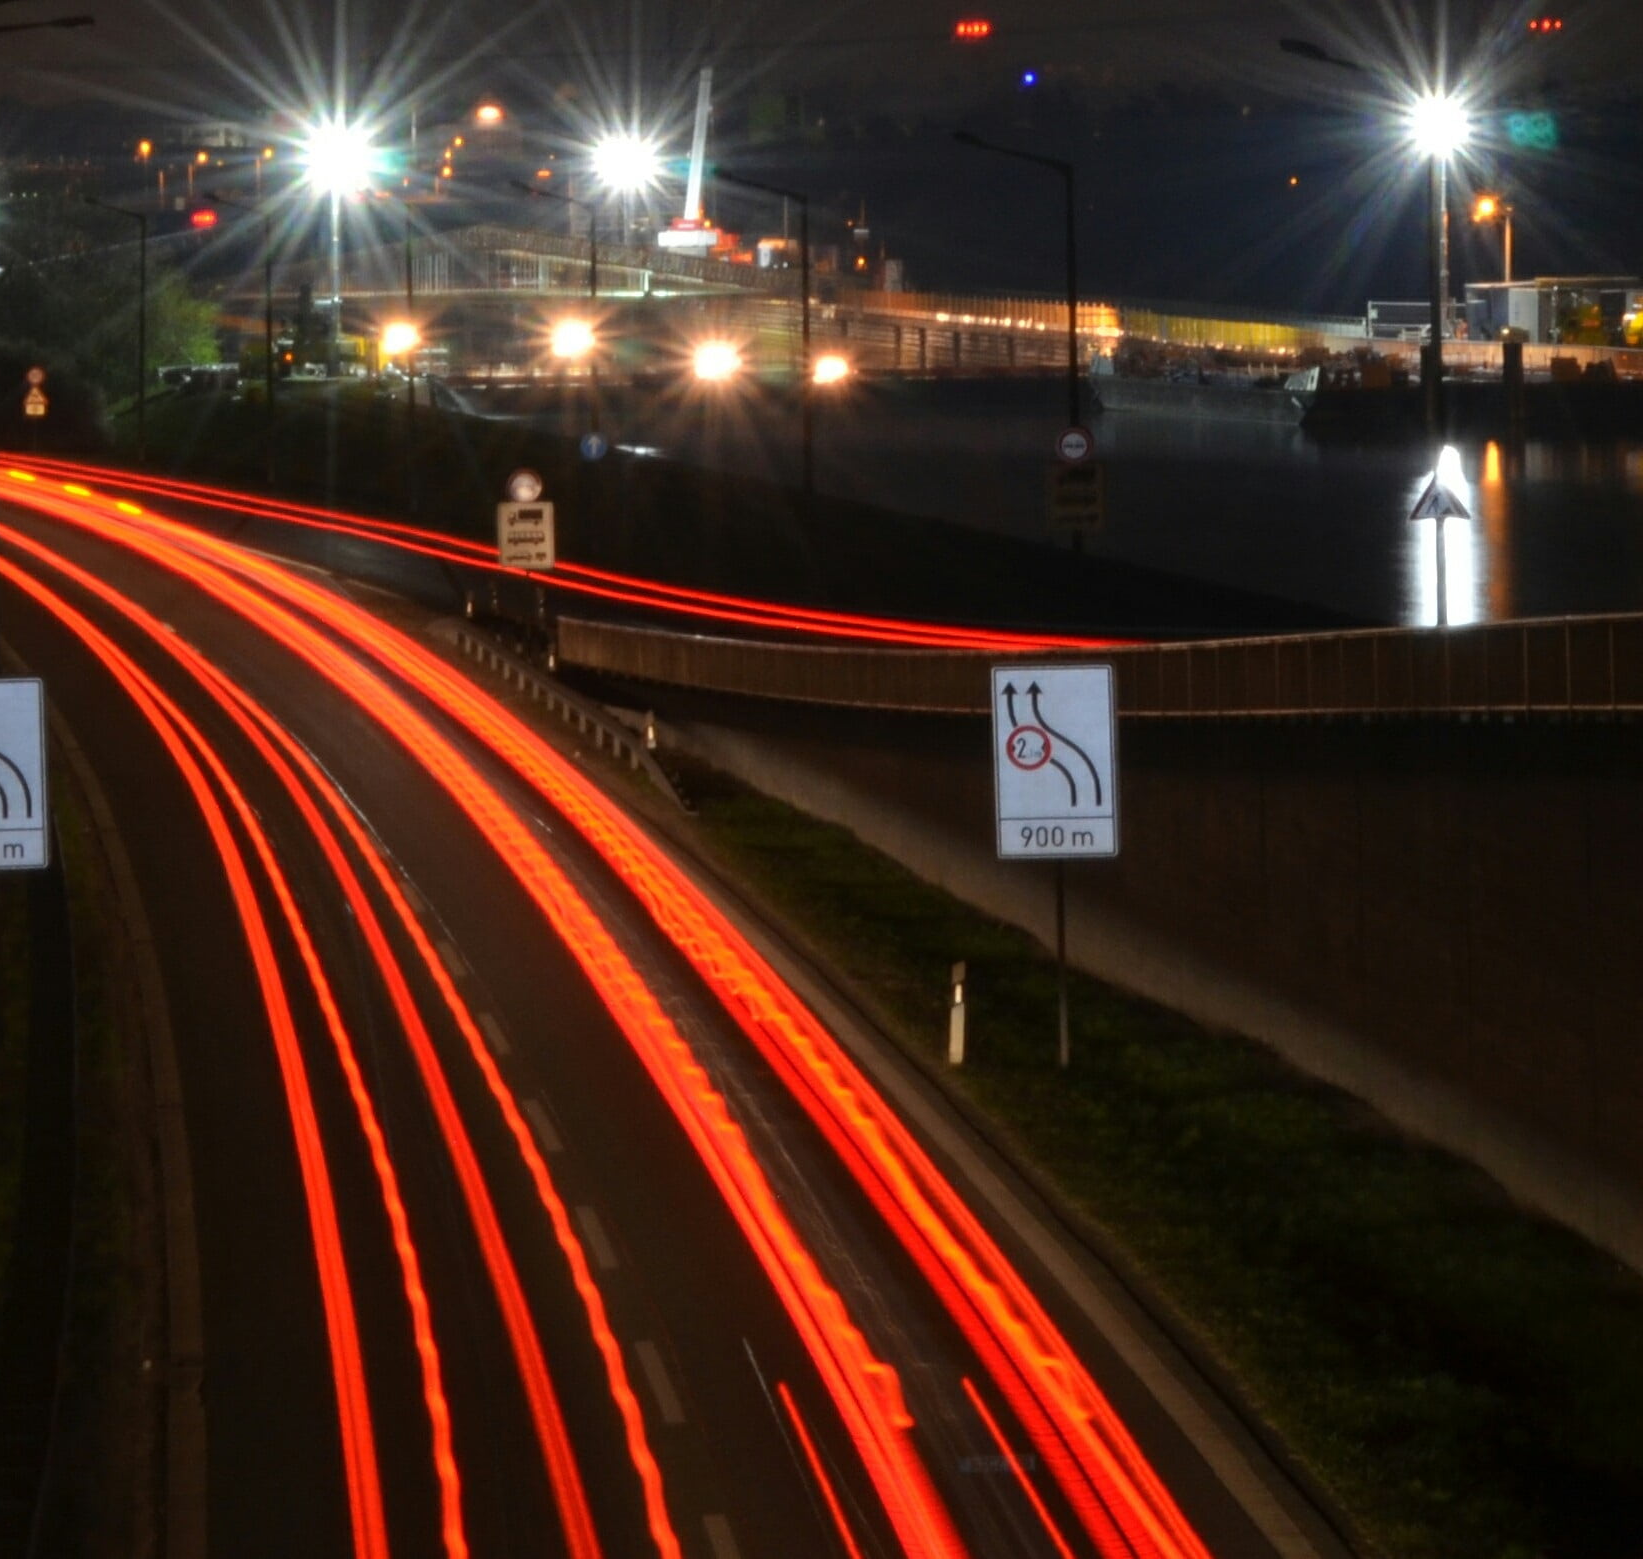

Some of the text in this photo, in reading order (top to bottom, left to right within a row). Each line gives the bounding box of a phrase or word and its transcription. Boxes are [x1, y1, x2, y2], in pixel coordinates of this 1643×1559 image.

[1020, 826, 1094, 848] 900 m
[3, 842, 24, 859] m
